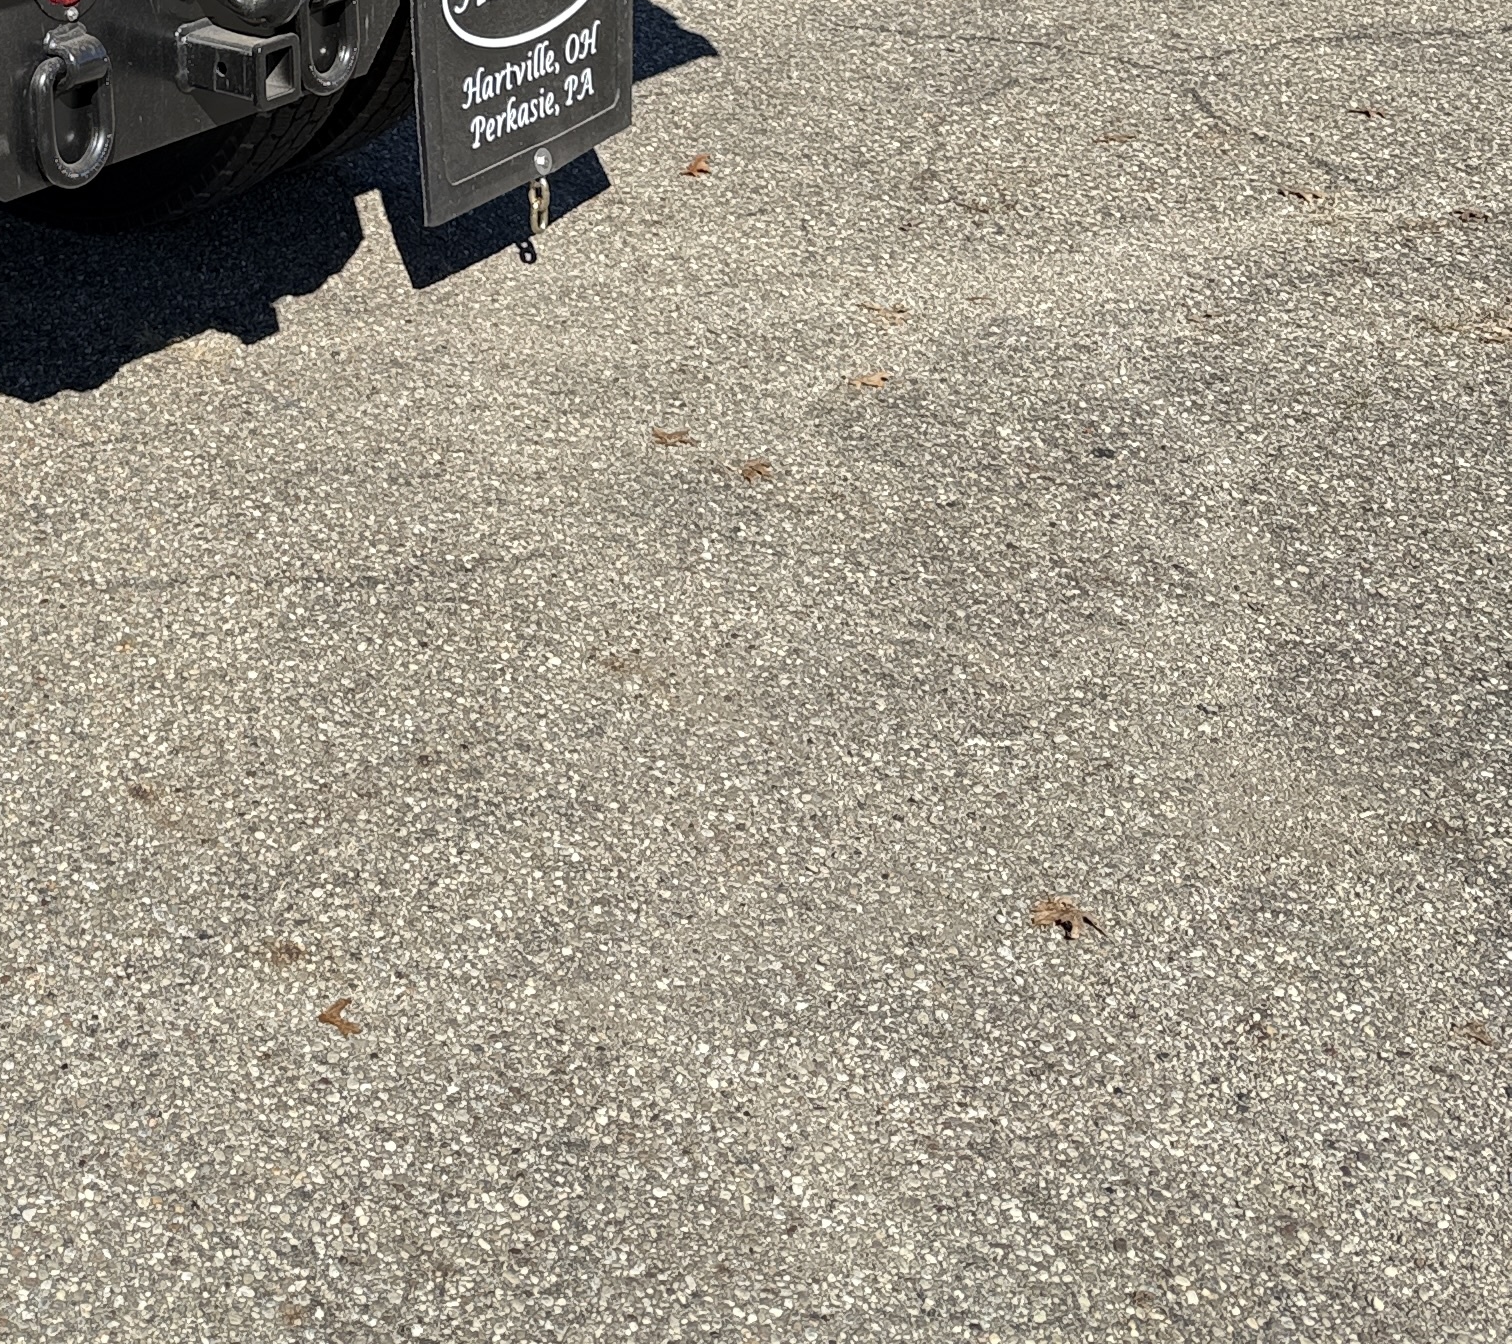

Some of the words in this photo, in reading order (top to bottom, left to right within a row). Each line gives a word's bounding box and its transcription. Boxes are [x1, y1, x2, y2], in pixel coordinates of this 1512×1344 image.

[462, 40, 560, 110] Hartville,
[565, 20, 601, 65] OH
[470, 87, 560, 149] Perkasie,
[564, 67, 594, 107] PA
